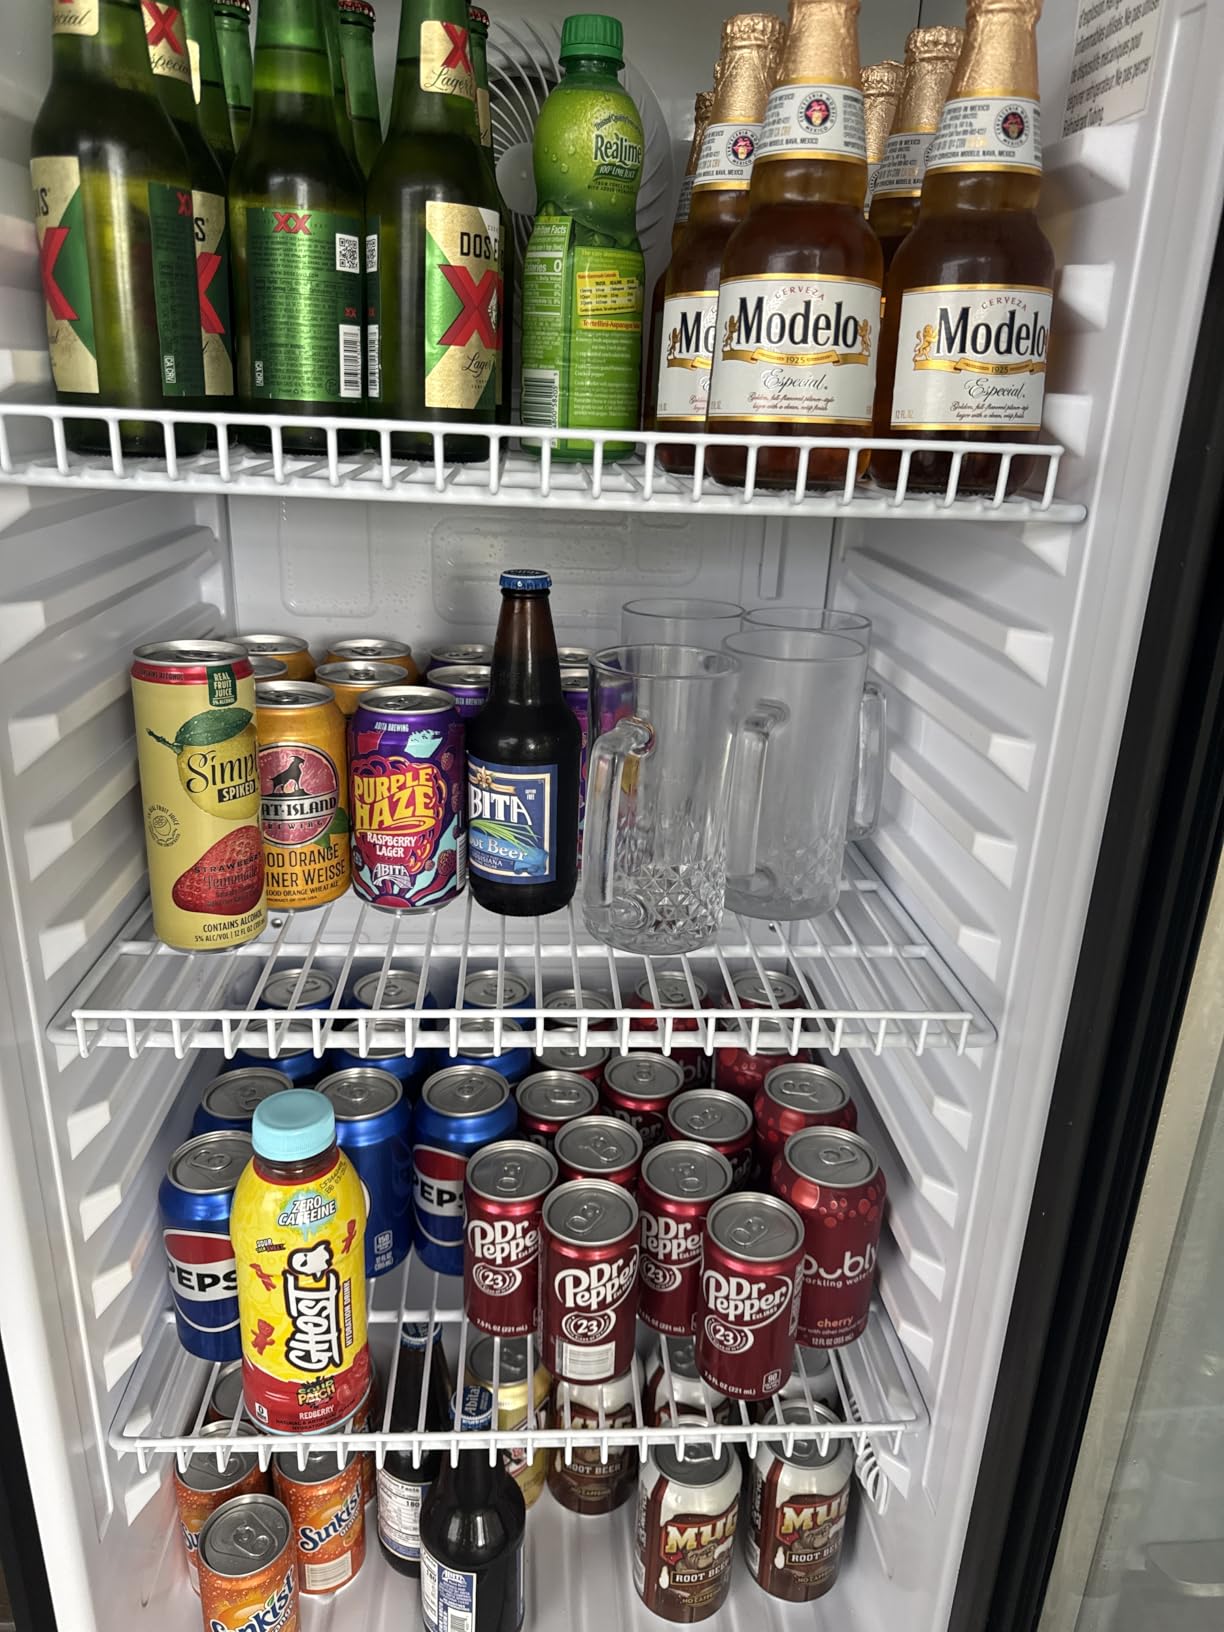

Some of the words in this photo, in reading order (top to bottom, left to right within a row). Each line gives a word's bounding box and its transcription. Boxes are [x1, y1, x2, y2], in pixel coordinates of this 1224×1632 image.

[460, 231, 491, 260] DOS
[775, 286, 825, 301] CERVEZA
[981, 296, 1027, 312] CERVEZA
[735, 296, 859, 348] Modelo
[936, 307, 1046, 357] Modelo
[786, 356, 806, 364] 1925
[991, 366, 1009, 374] 1925
[213, 672, 230, 681] REAL
[214, 680, 232, 690] FRUIT
[214, 688, 232, 698] JUICE
[388, 723, 410, 732] BREWING
[222, 781, 255, 801] SPIKED
[354, 767, 434, 803] PURPLE
[355, 787, 435, 830] HAZE
[367, 831, 418, 847] RASPBERRY
[289, 843, 340, 867] ORANGE
[376, 845, 405, 858] LAGER
[488, 839, 528, 861] Beer
[303, 859, 346, 885] WEISSE
[374, 862, 410, 877] ABITA
[283, 888, 310, 897] ORANGE
[310, 884, 329, 895] WHEAT
[203, 920, 239, 933] CONTAINS
[240, 909, 263, 926] ALCOHOL
[205, 933, 229, 942] ALC/VOL
[292, 1194, 322, 1214] ZERO
[278, 1200, 337, 1226] CAFFEINE
[494, 1219, 530, 1242] Dr
[484, 1271, 504, 1288] 23
[589, 1257, 624, 1289] Dr
[648, 1265, 664, 1282] 23
[555, 1254, 637, 1312] Pepper
[729, 1276, 766, 1301] Dr
[576, 1319, 600, 1336] 23
[816, 1315, 854, 1328] cherry
[715, 1324, 735, 1344] 23
[719, 1381, 728, 1390] OZ
[298, 1386, 336, 1406] PATCH
[299, 1405, 335, 1420] REDBERRY
[299, 1481, 362, 1552] Sunkist
[791, 1551, 821, 1563] ROOT
[675, 1571, 706, 1583] ROOT
